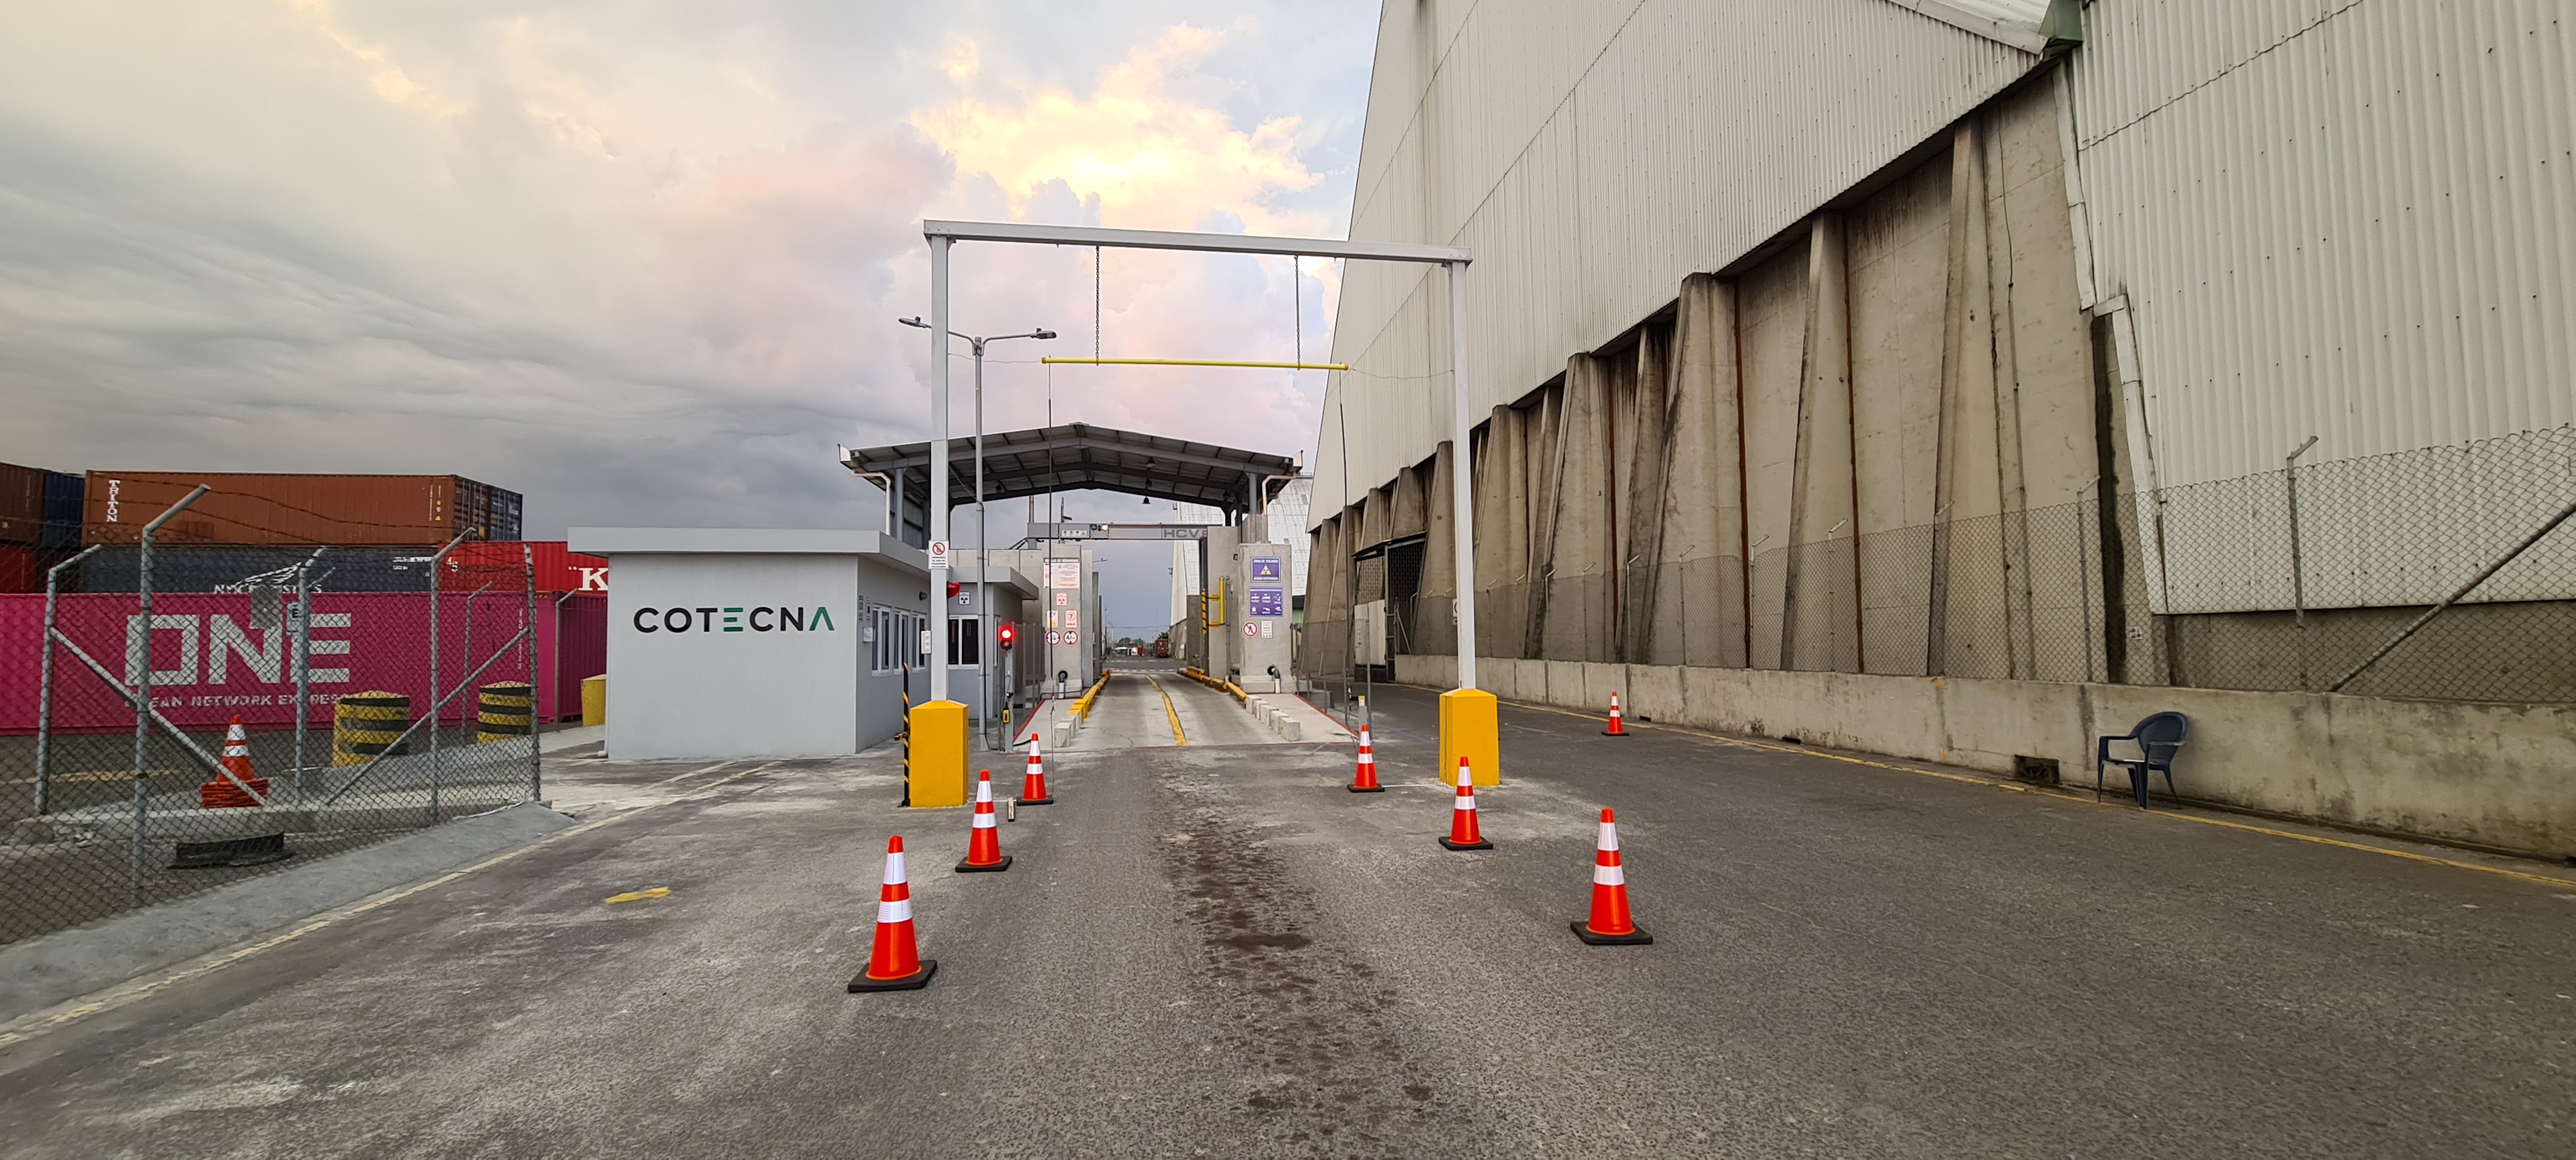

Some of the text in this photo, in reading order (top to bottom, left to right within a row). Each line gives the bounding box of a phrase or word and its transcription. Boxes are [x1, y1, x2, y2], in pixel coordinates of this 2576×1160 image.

[106, 480, 121, 523] TRITON
[634, 607, 834, 632] COTECNA
[125, 614, 351, 685] ONE
[192, 695, 272, 706] NETWORK
